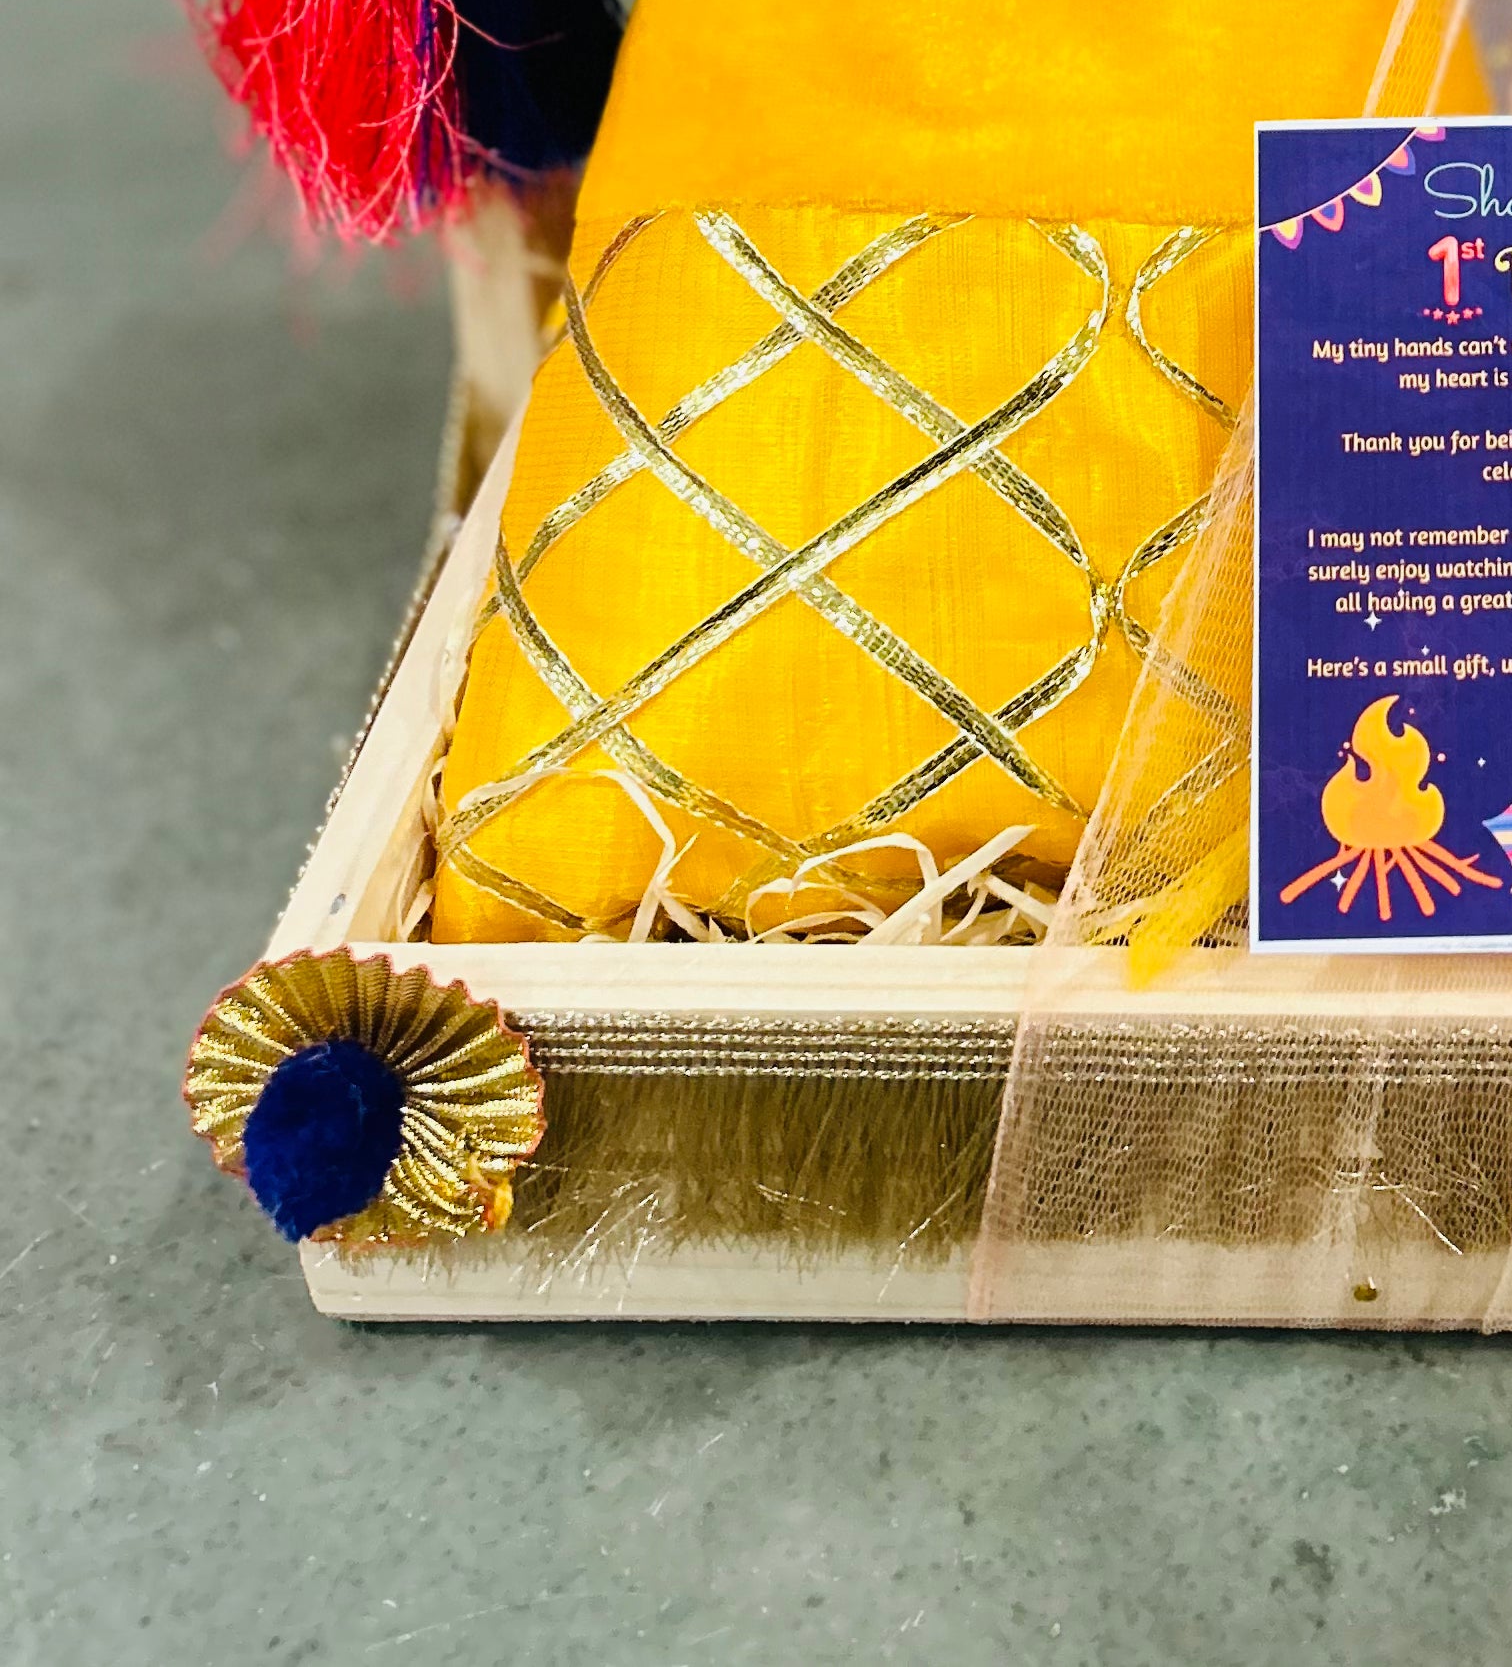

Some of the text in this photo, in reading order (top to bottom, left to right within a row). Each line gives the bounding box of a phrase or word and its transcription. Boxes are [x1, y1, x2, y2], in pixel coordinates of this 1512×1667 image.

[1313, 340, 1344, 363] My
[1349, 338, 1388, 362] tiny
[1395, 337, 1453, 357] hands
[1459, 335, 1507, 356] can't
[1400, 374, 1430, 393] my
[1436, 369, 1488, 388] heart
[1494, 368, 1508, 386] is
[1342, 432, 1402, 452] Thank
[1409, 436, 1445, 455] you
[1451, 431, 1480, 455] for
[1309, 529, 1314, 547] I
[1320, 533, 1364, 552] may
[1370, 529, 1403, 546] not
[1409, 526, 1509, 546] remember
[1309, 561, 1370, 584] surely
[1376, 560, 1430, 584] enjoy
[1336, 592, 1362, 612] all
[1368, 590, 1436, 615] having
[1442, 595, 1454, 610] a
[1460, 591, 1512, 613] great
[1308, 657, 1368, 677] Here's
[1374, 661, 1386, 676] a
[1393, 654, 1448, 676] small
[1453, 654, 1495, 679] gift,
